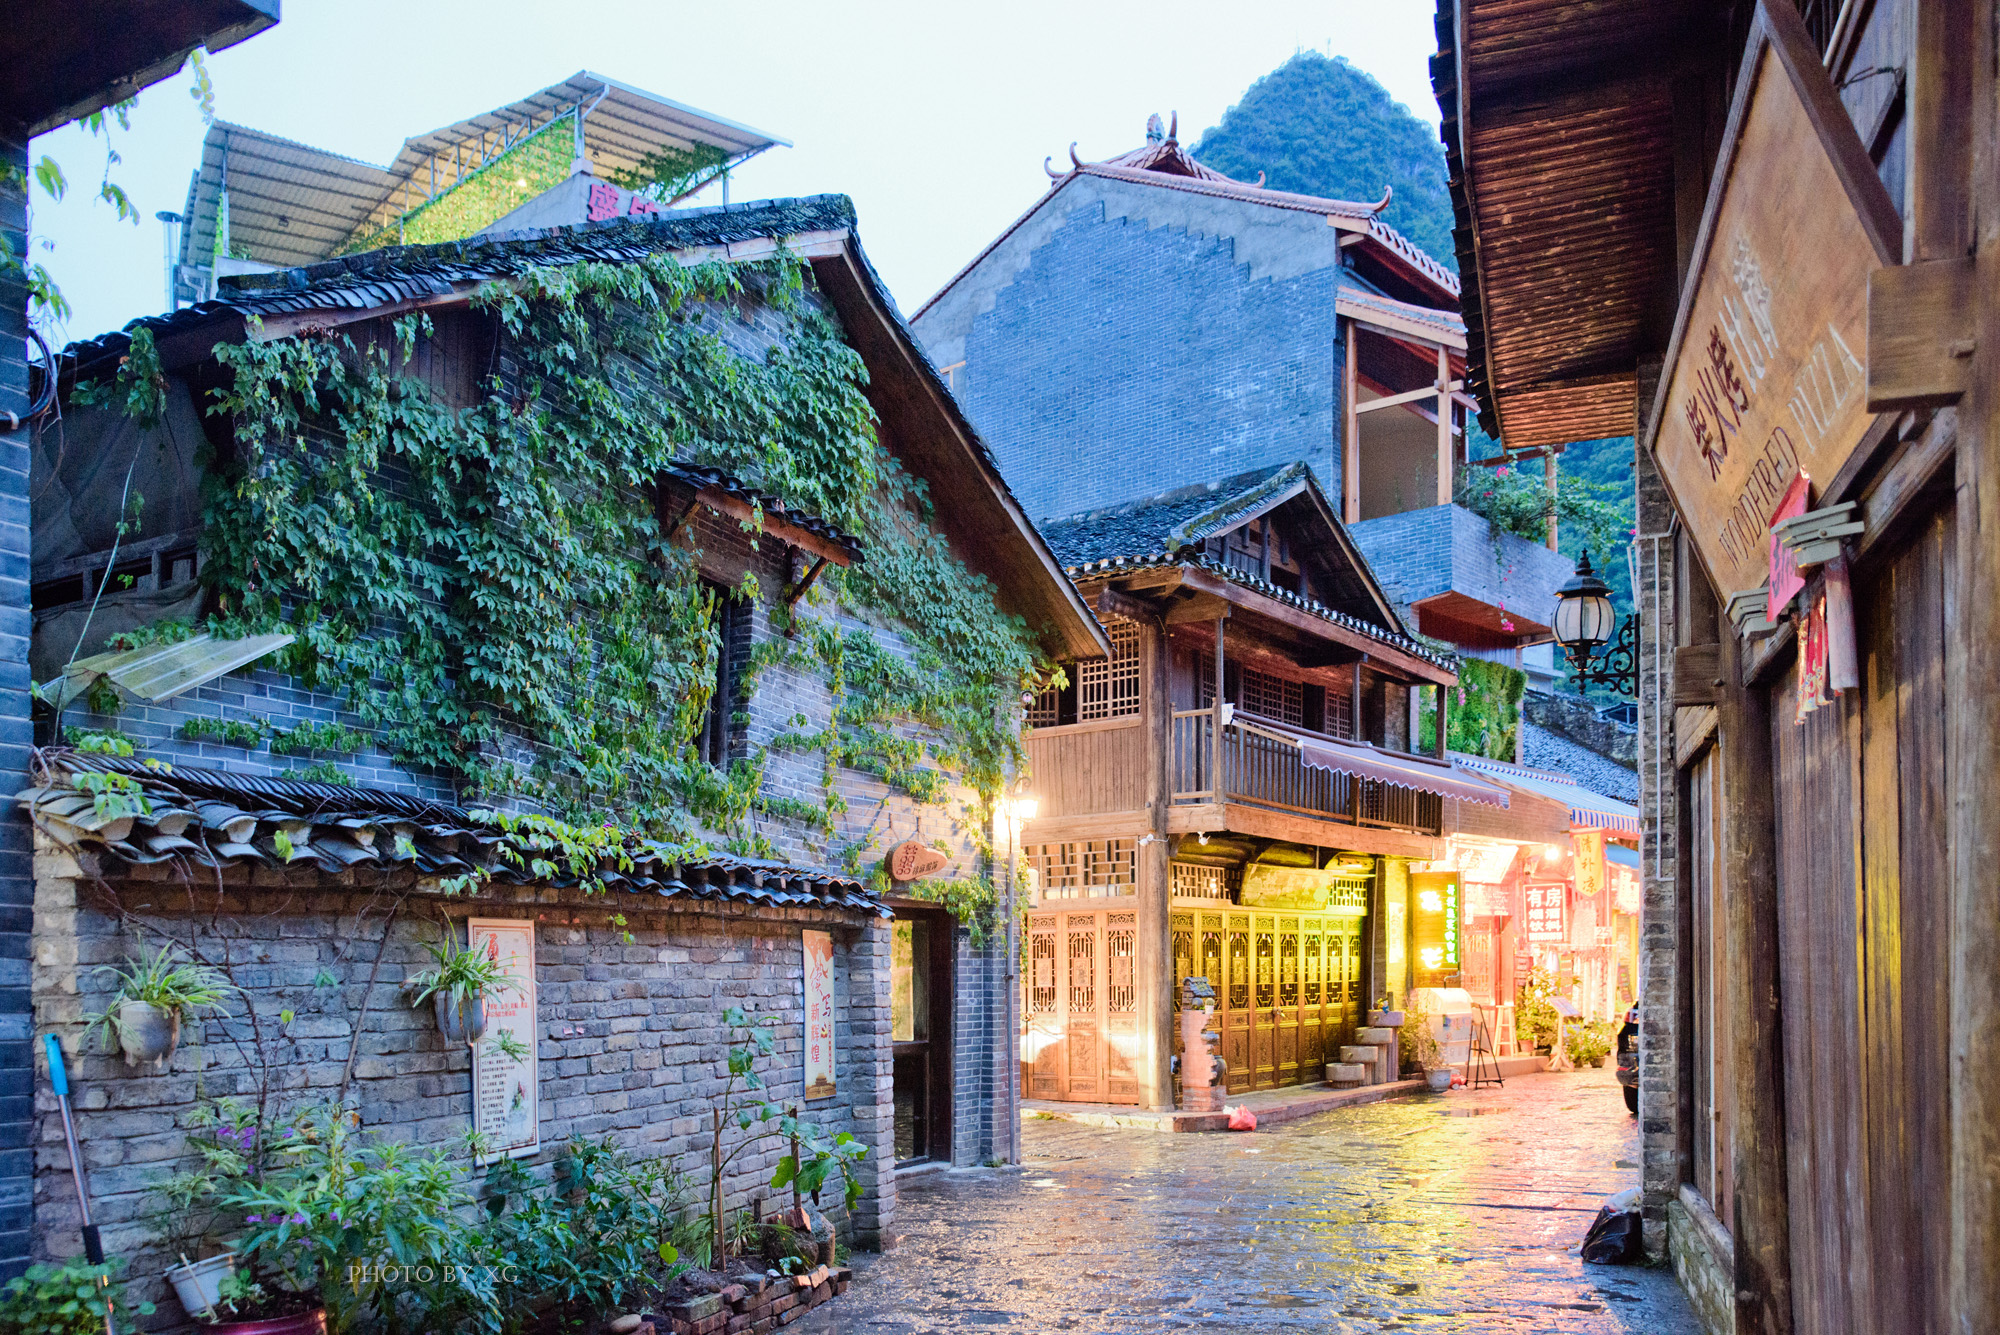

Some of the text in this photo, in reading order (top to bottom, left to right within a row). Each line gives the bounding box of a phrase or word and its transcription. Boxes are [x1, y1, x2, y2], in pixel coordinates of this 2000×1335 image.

[1787, 321, 1864, 454] PIZZA
[1719, 426, 1799, 572] WOODFIRED
[1526, 887, 1563, 908] 有房
[1528, 908, 1561, 920] 烟酒
[1528, 920, 1563, 932] 饮料
